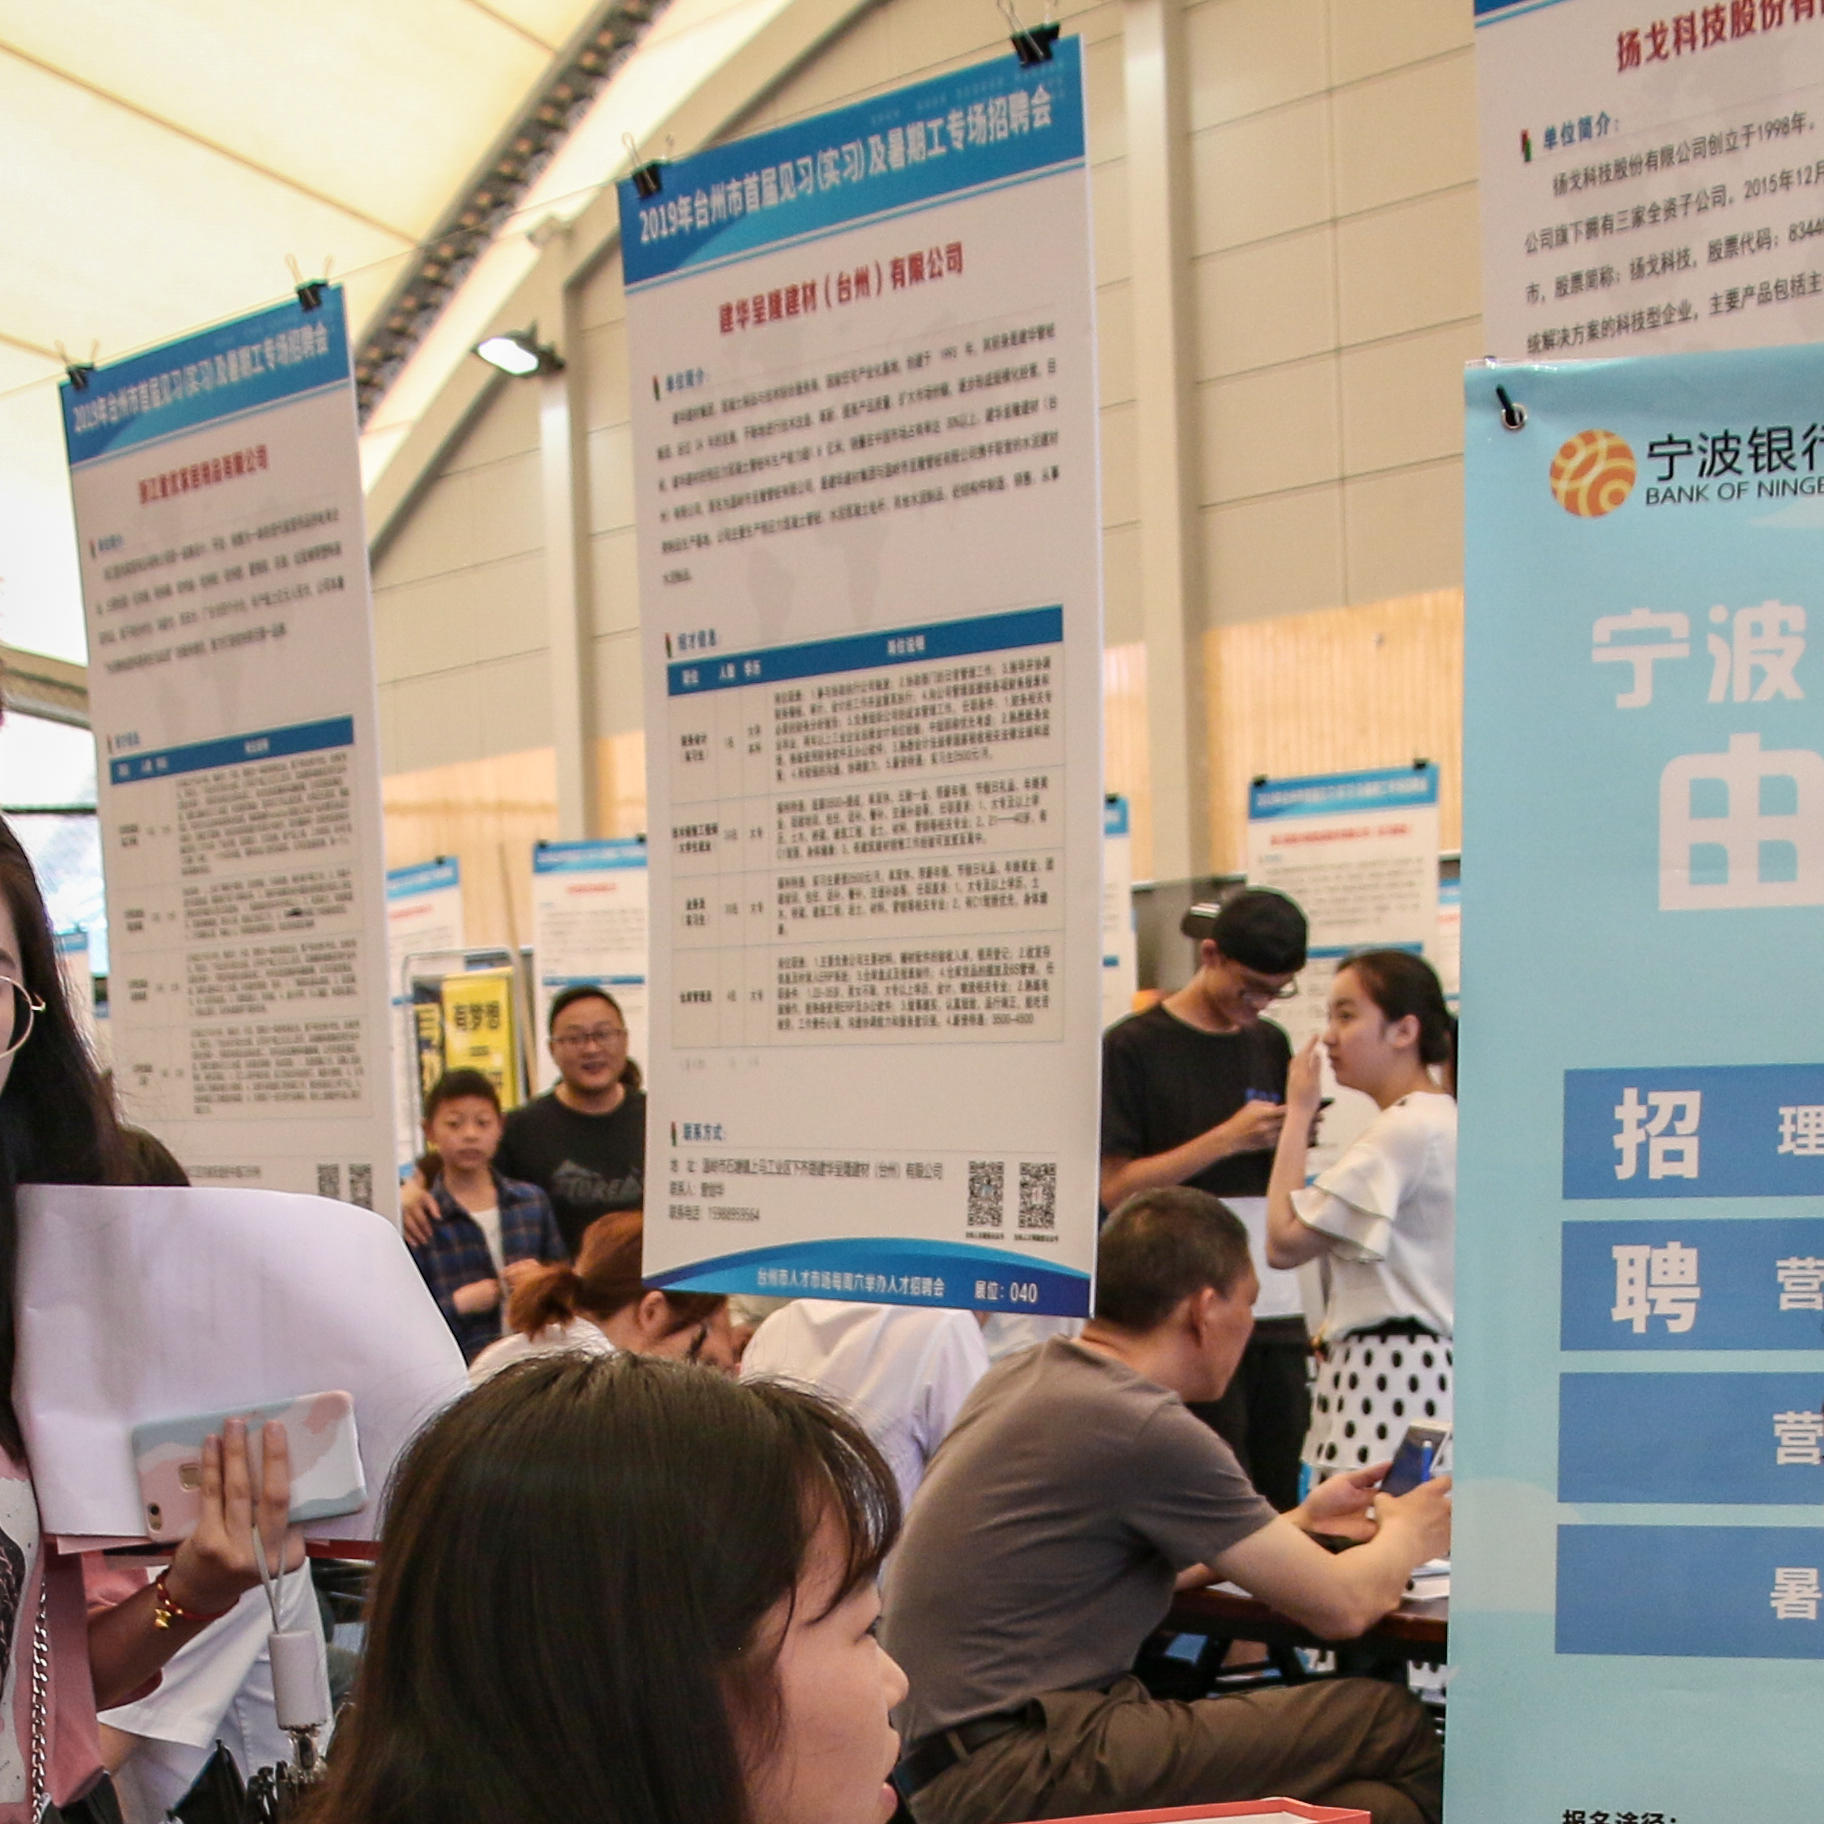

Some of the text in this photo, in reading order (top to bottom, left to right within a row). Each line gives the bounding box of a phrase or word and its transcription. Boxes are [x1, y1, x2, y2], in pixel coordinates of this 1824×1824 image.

[1645, 484, 1710, 505] BANK
[1717, 480, 1749, 501] OF
[1614, 1087, 1703, 1182] 招
[1610, 1243, 1703, 1336] 聘
